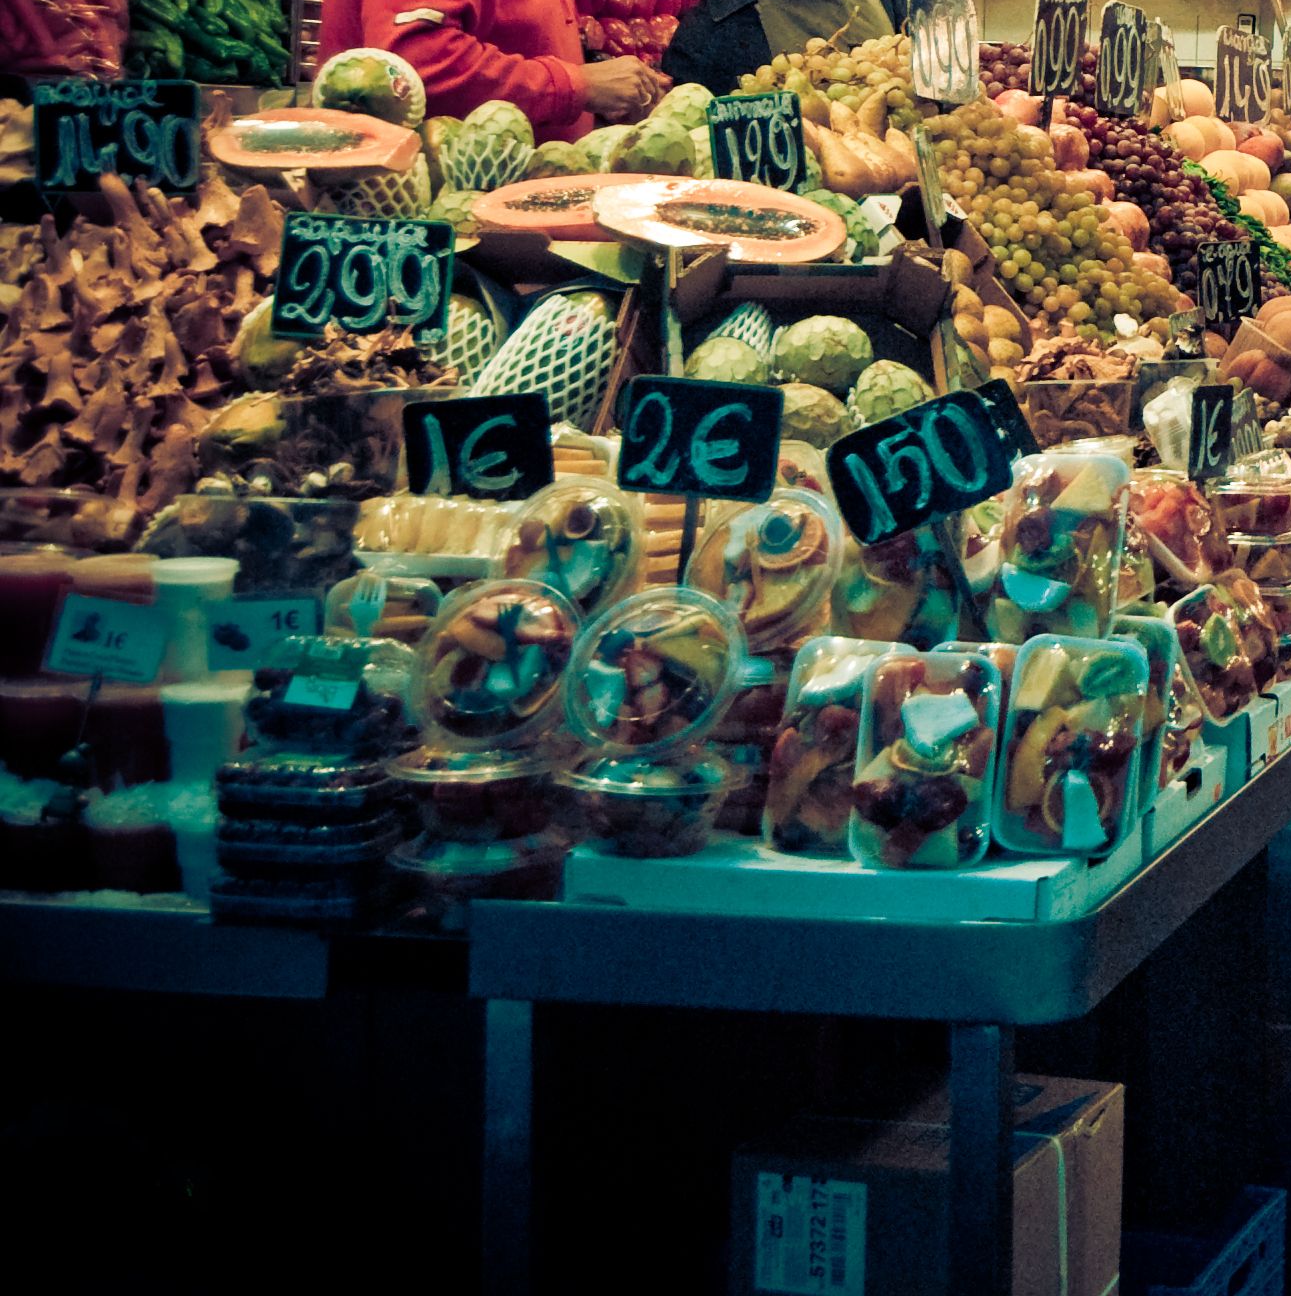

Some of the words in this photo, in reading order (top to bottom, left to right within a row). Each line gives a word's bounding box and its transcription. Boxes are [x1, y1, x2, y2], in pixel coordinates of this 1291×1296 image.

[422, 413, 525, 495] 1€
[624, 391, 753, 487] 2€
[272, 609, 301, 631] 1€
